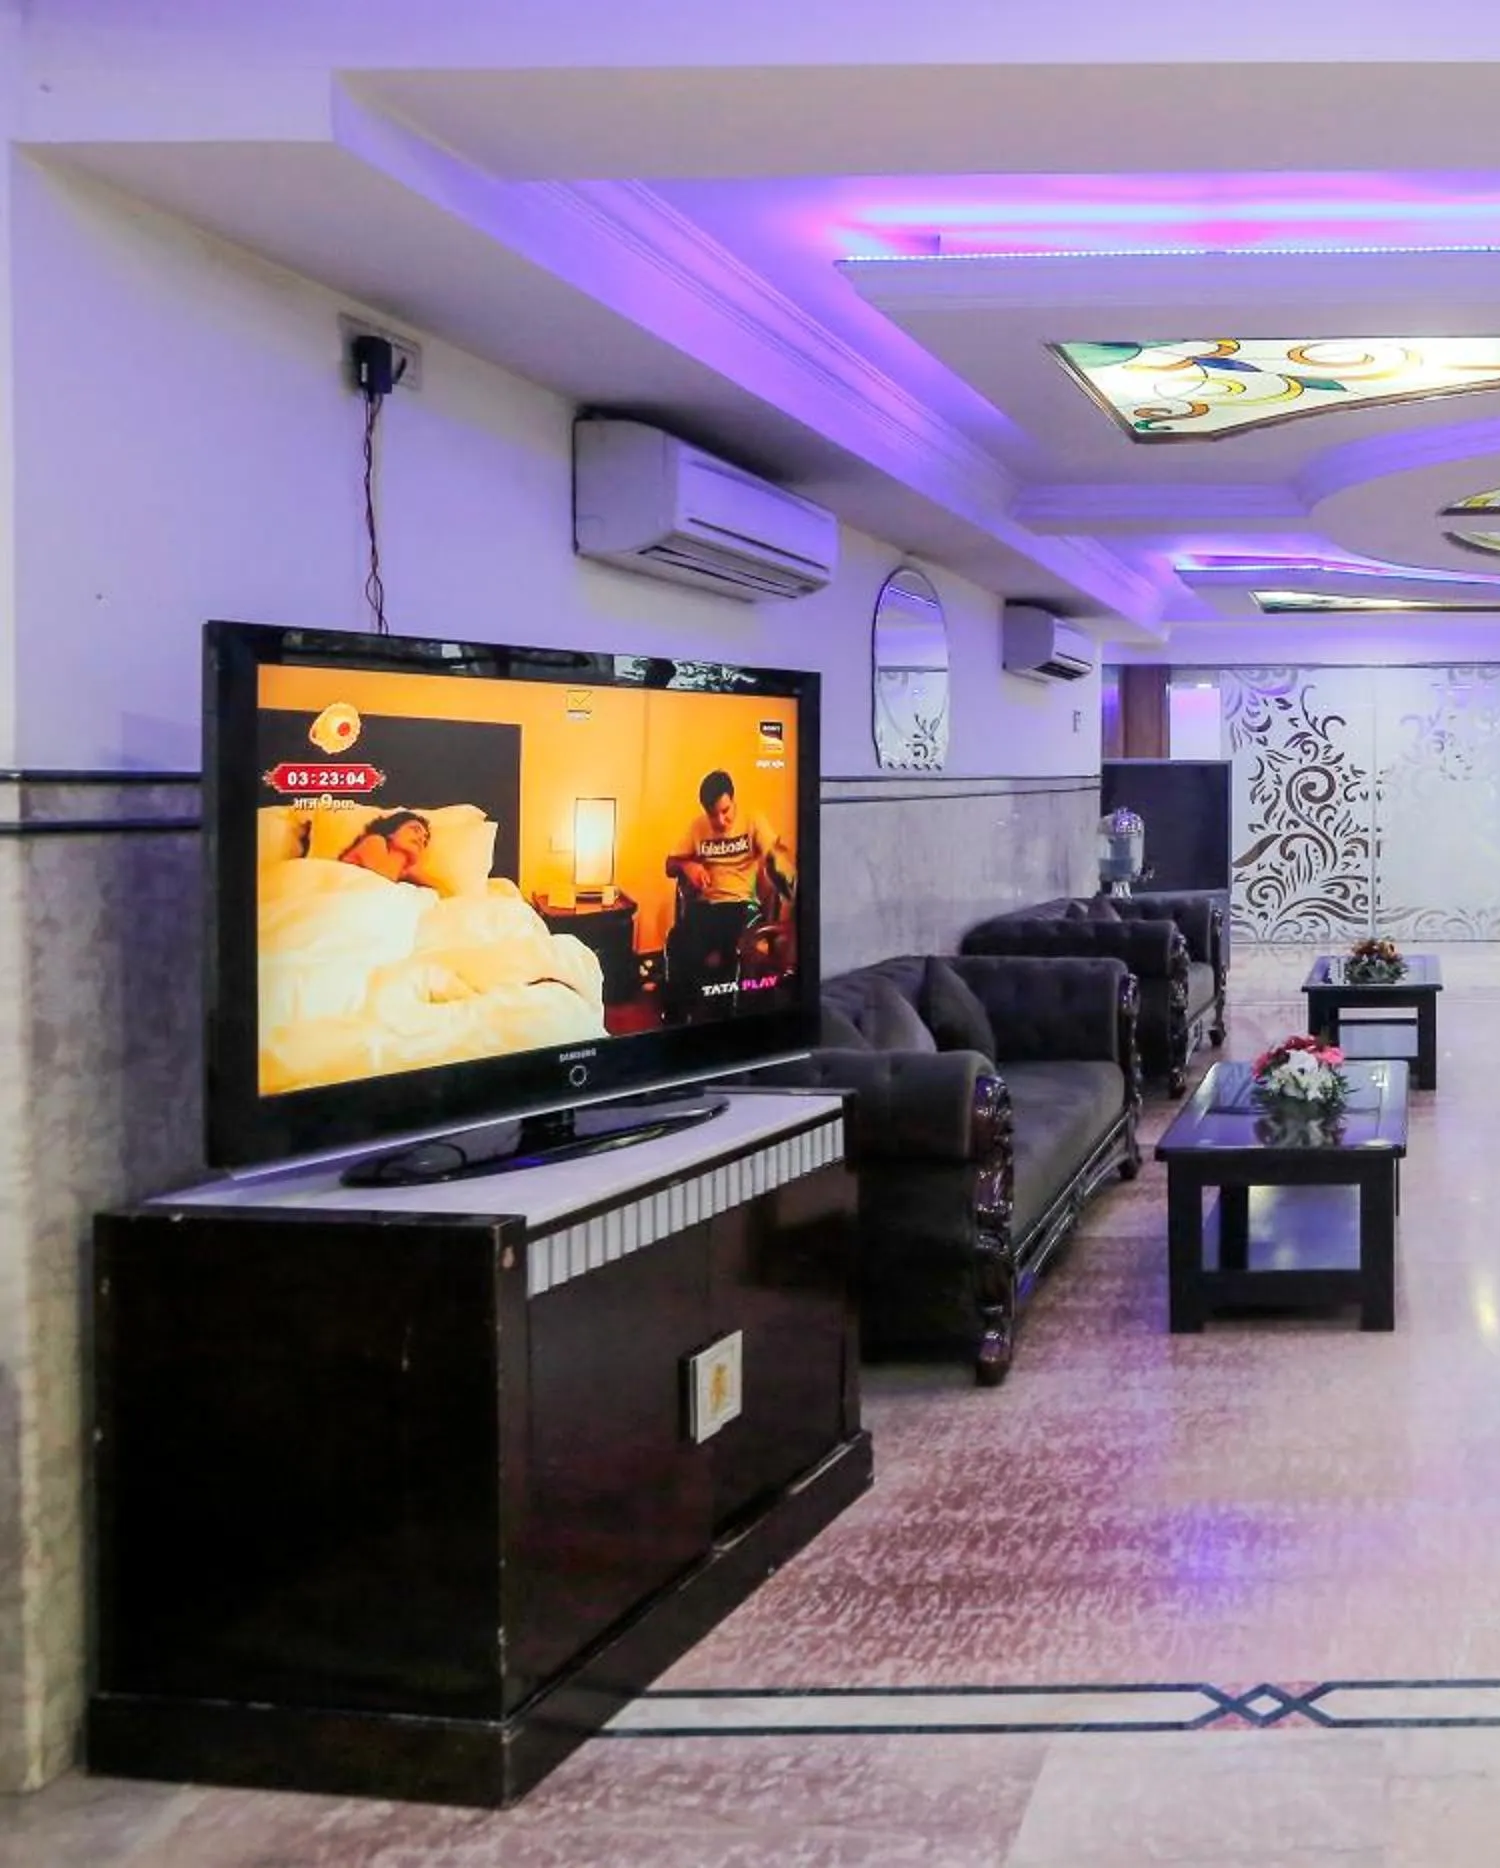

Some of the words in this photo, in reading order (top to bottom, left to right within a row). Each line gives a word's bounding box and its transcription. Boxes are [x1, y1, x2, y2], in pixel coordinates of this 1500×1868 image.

[287, 771, 366, 786] 03:23:04
[701, 981, 739, 997] TATA
[742, 975, 778, 991] PLAY
